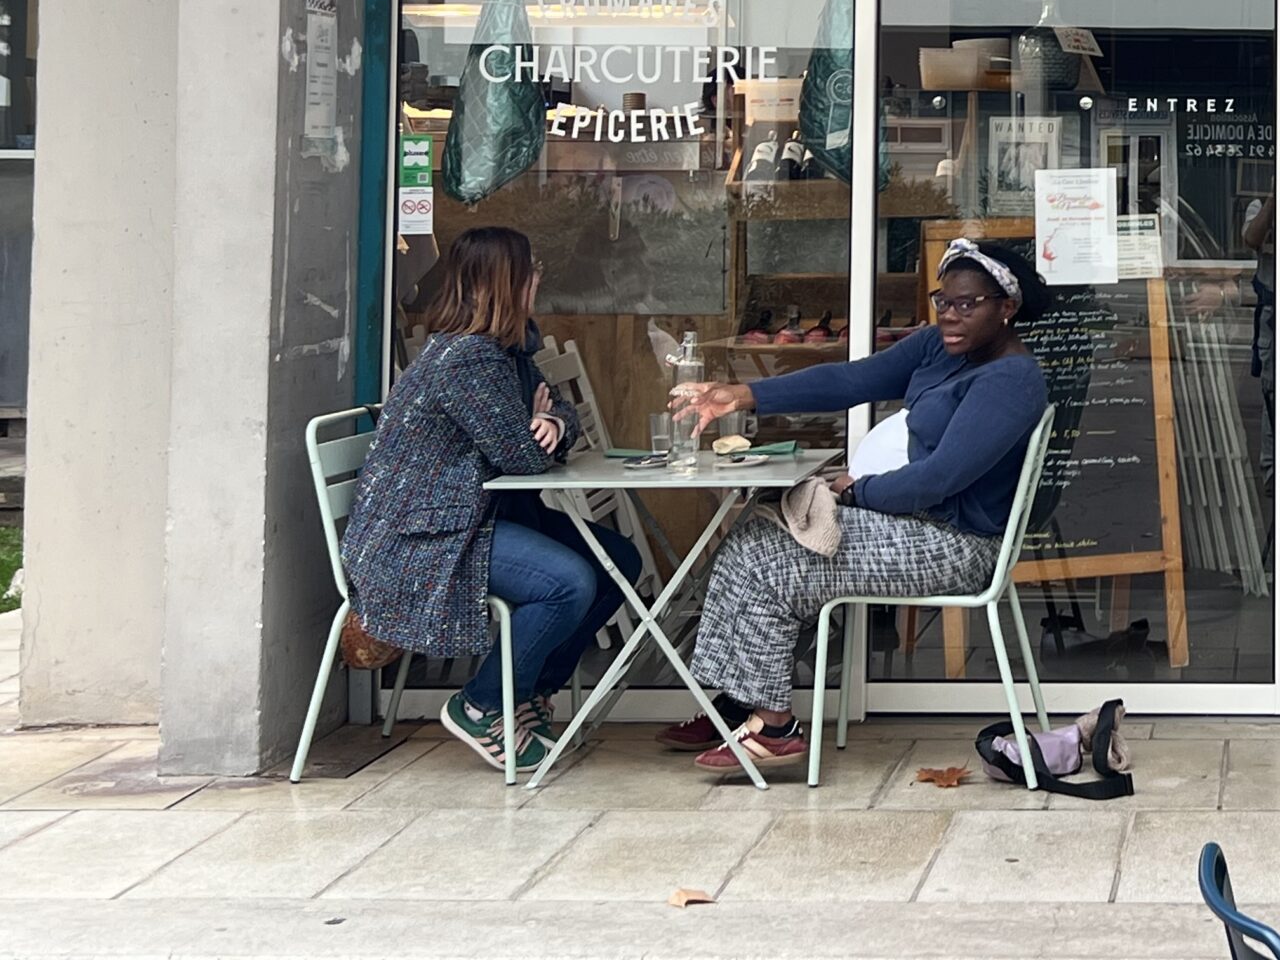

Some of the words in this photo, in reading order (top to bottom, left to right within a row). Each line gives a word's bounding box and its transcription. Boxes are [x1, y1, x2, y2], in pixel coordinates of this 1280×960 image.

[478, 44, 778, 85] CHARCUTERIE
[1128, 98, 1235, 113] ENTREZ
[550, 101, 705, 143] EPICERIE
[994, 122, 1055, 134] WANTED
